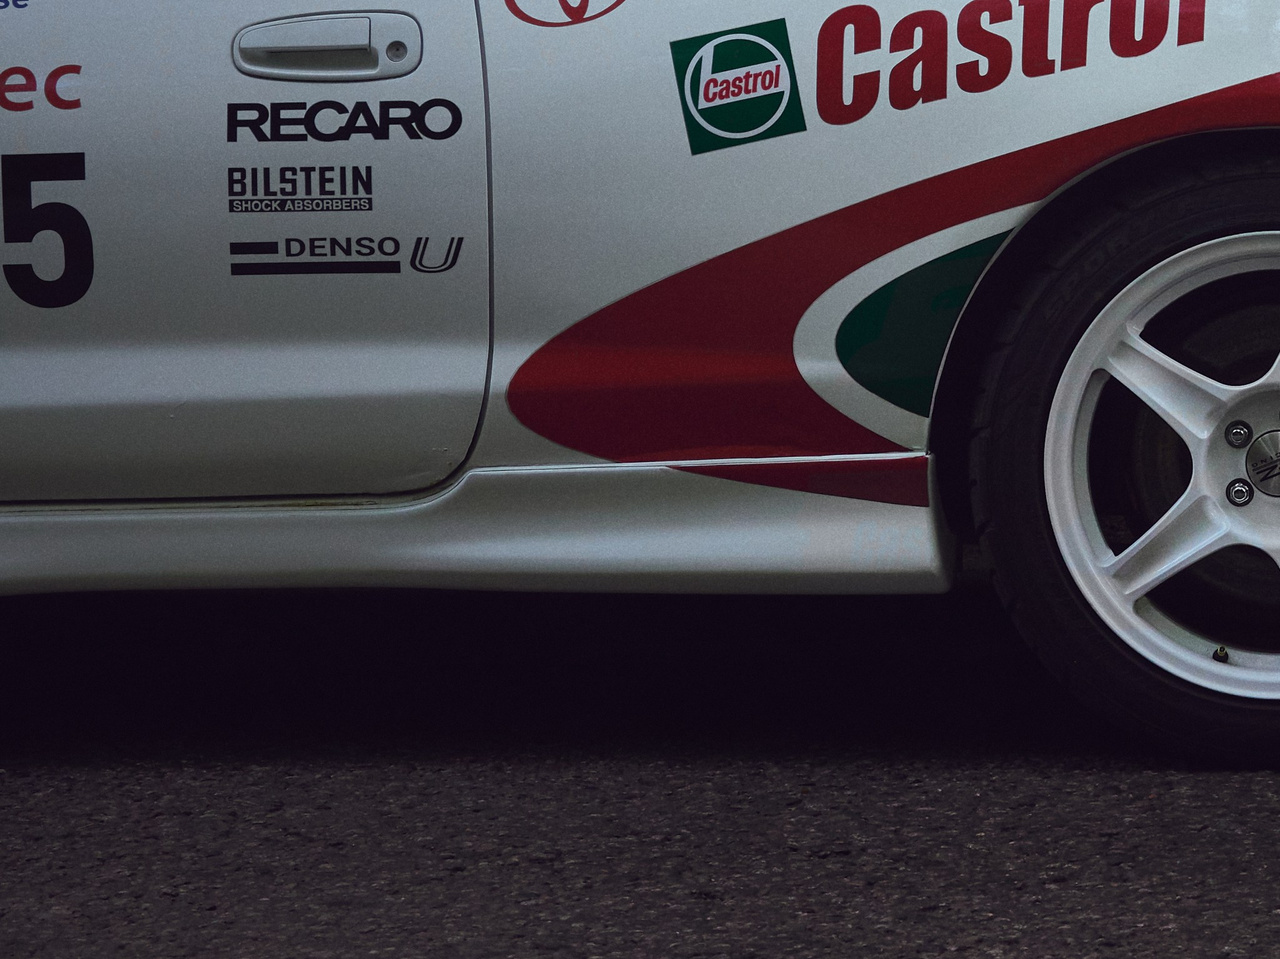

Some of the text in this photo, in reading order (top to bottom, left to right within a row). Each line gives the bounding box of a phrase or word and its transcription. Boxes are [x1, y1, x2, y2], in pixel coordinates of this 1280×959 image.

[0, 64, 82, 112] ec
[703, 64, 781, 103] Castrol
[227, 98, 463, 143] RECARO
[227, 166, 373, 197] BILSTEIN
[232, 198, 370, 212] SHOCK ABSORBERS
[1, 152, 94, 308] 5
[285, 237, 401, 257] DENSO
